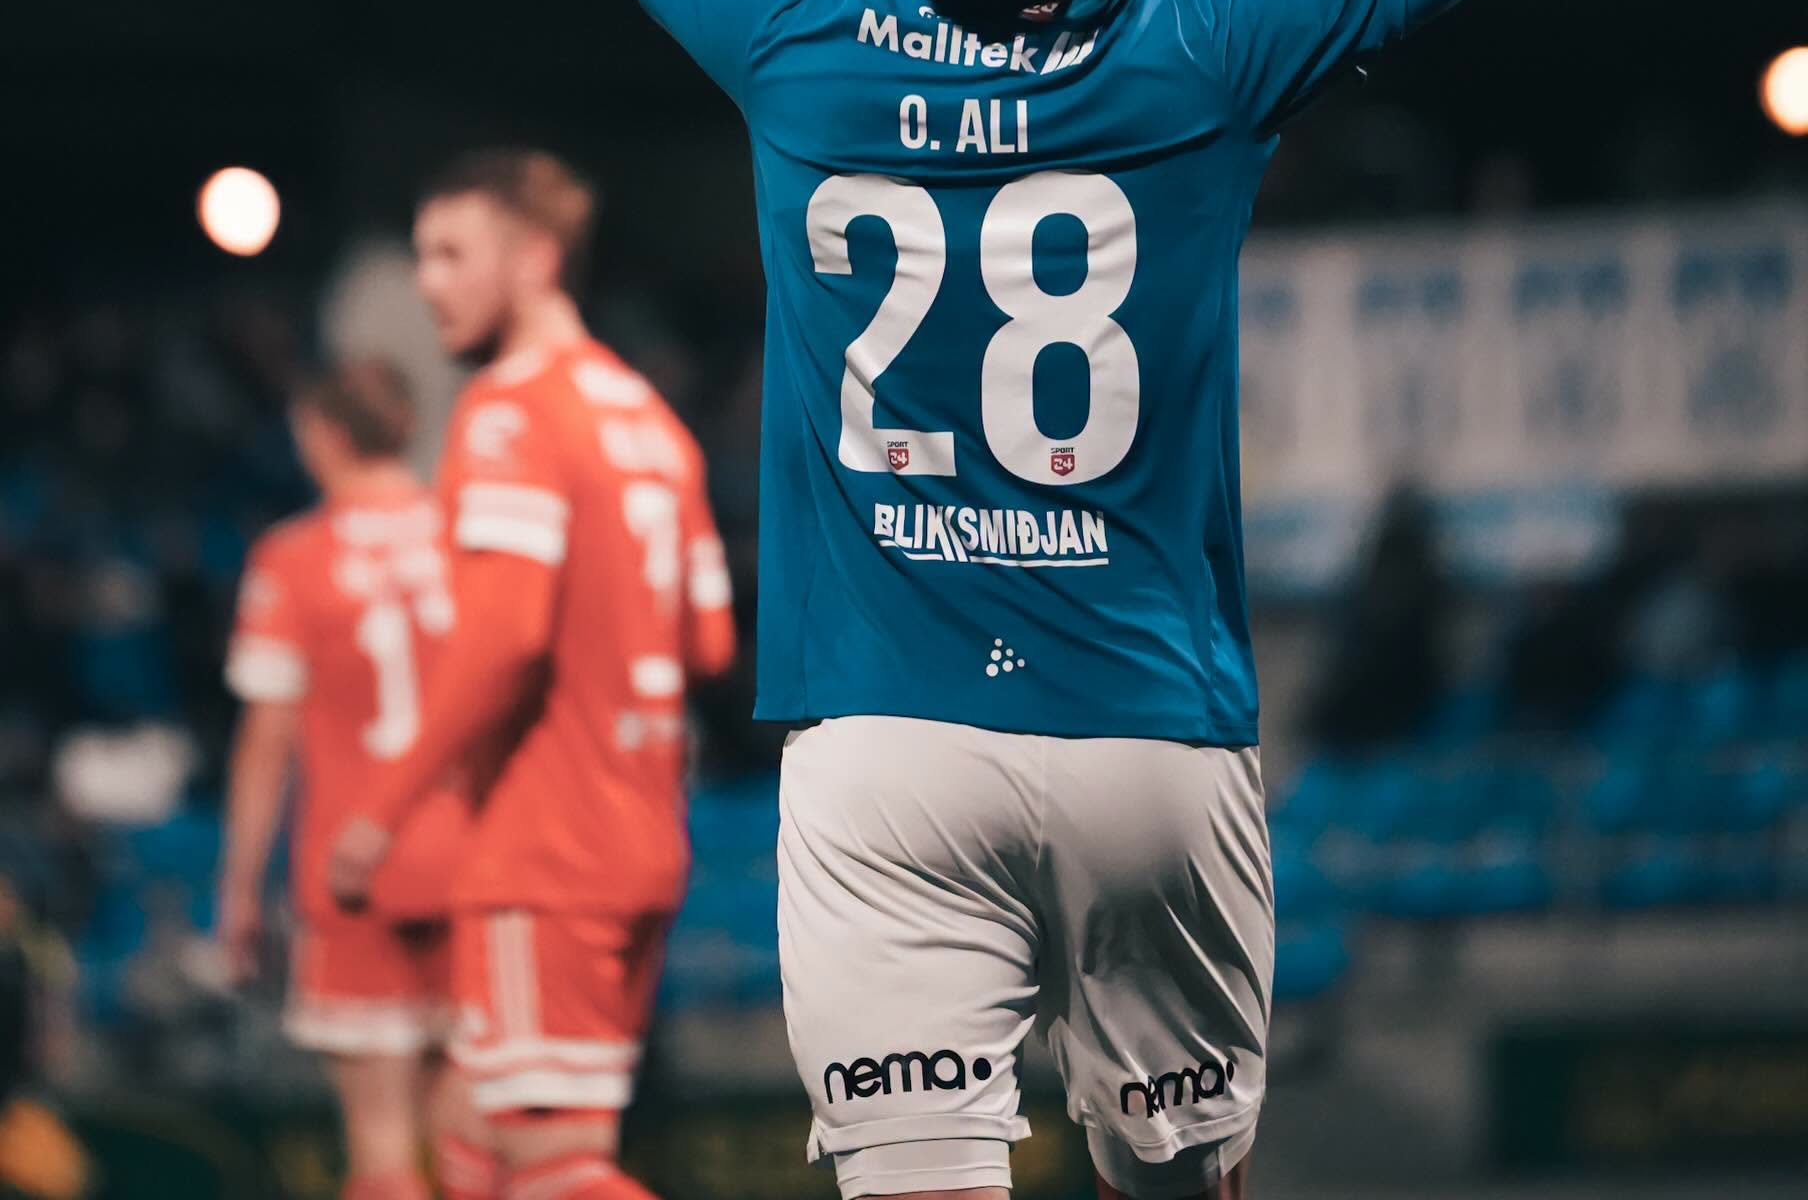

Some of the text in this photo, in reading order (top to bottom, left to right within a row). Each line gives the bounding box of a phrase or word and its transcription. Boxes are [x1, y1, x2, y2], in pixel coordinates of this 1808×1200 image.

[857, 7, 1039, 73] Malltek
[900, 94, 1028, 153] O. ALI
[806, 169, 1140, 486] 28
[890, 452, 908, 464] 24
[1053, 457, 1073, 470] 24
